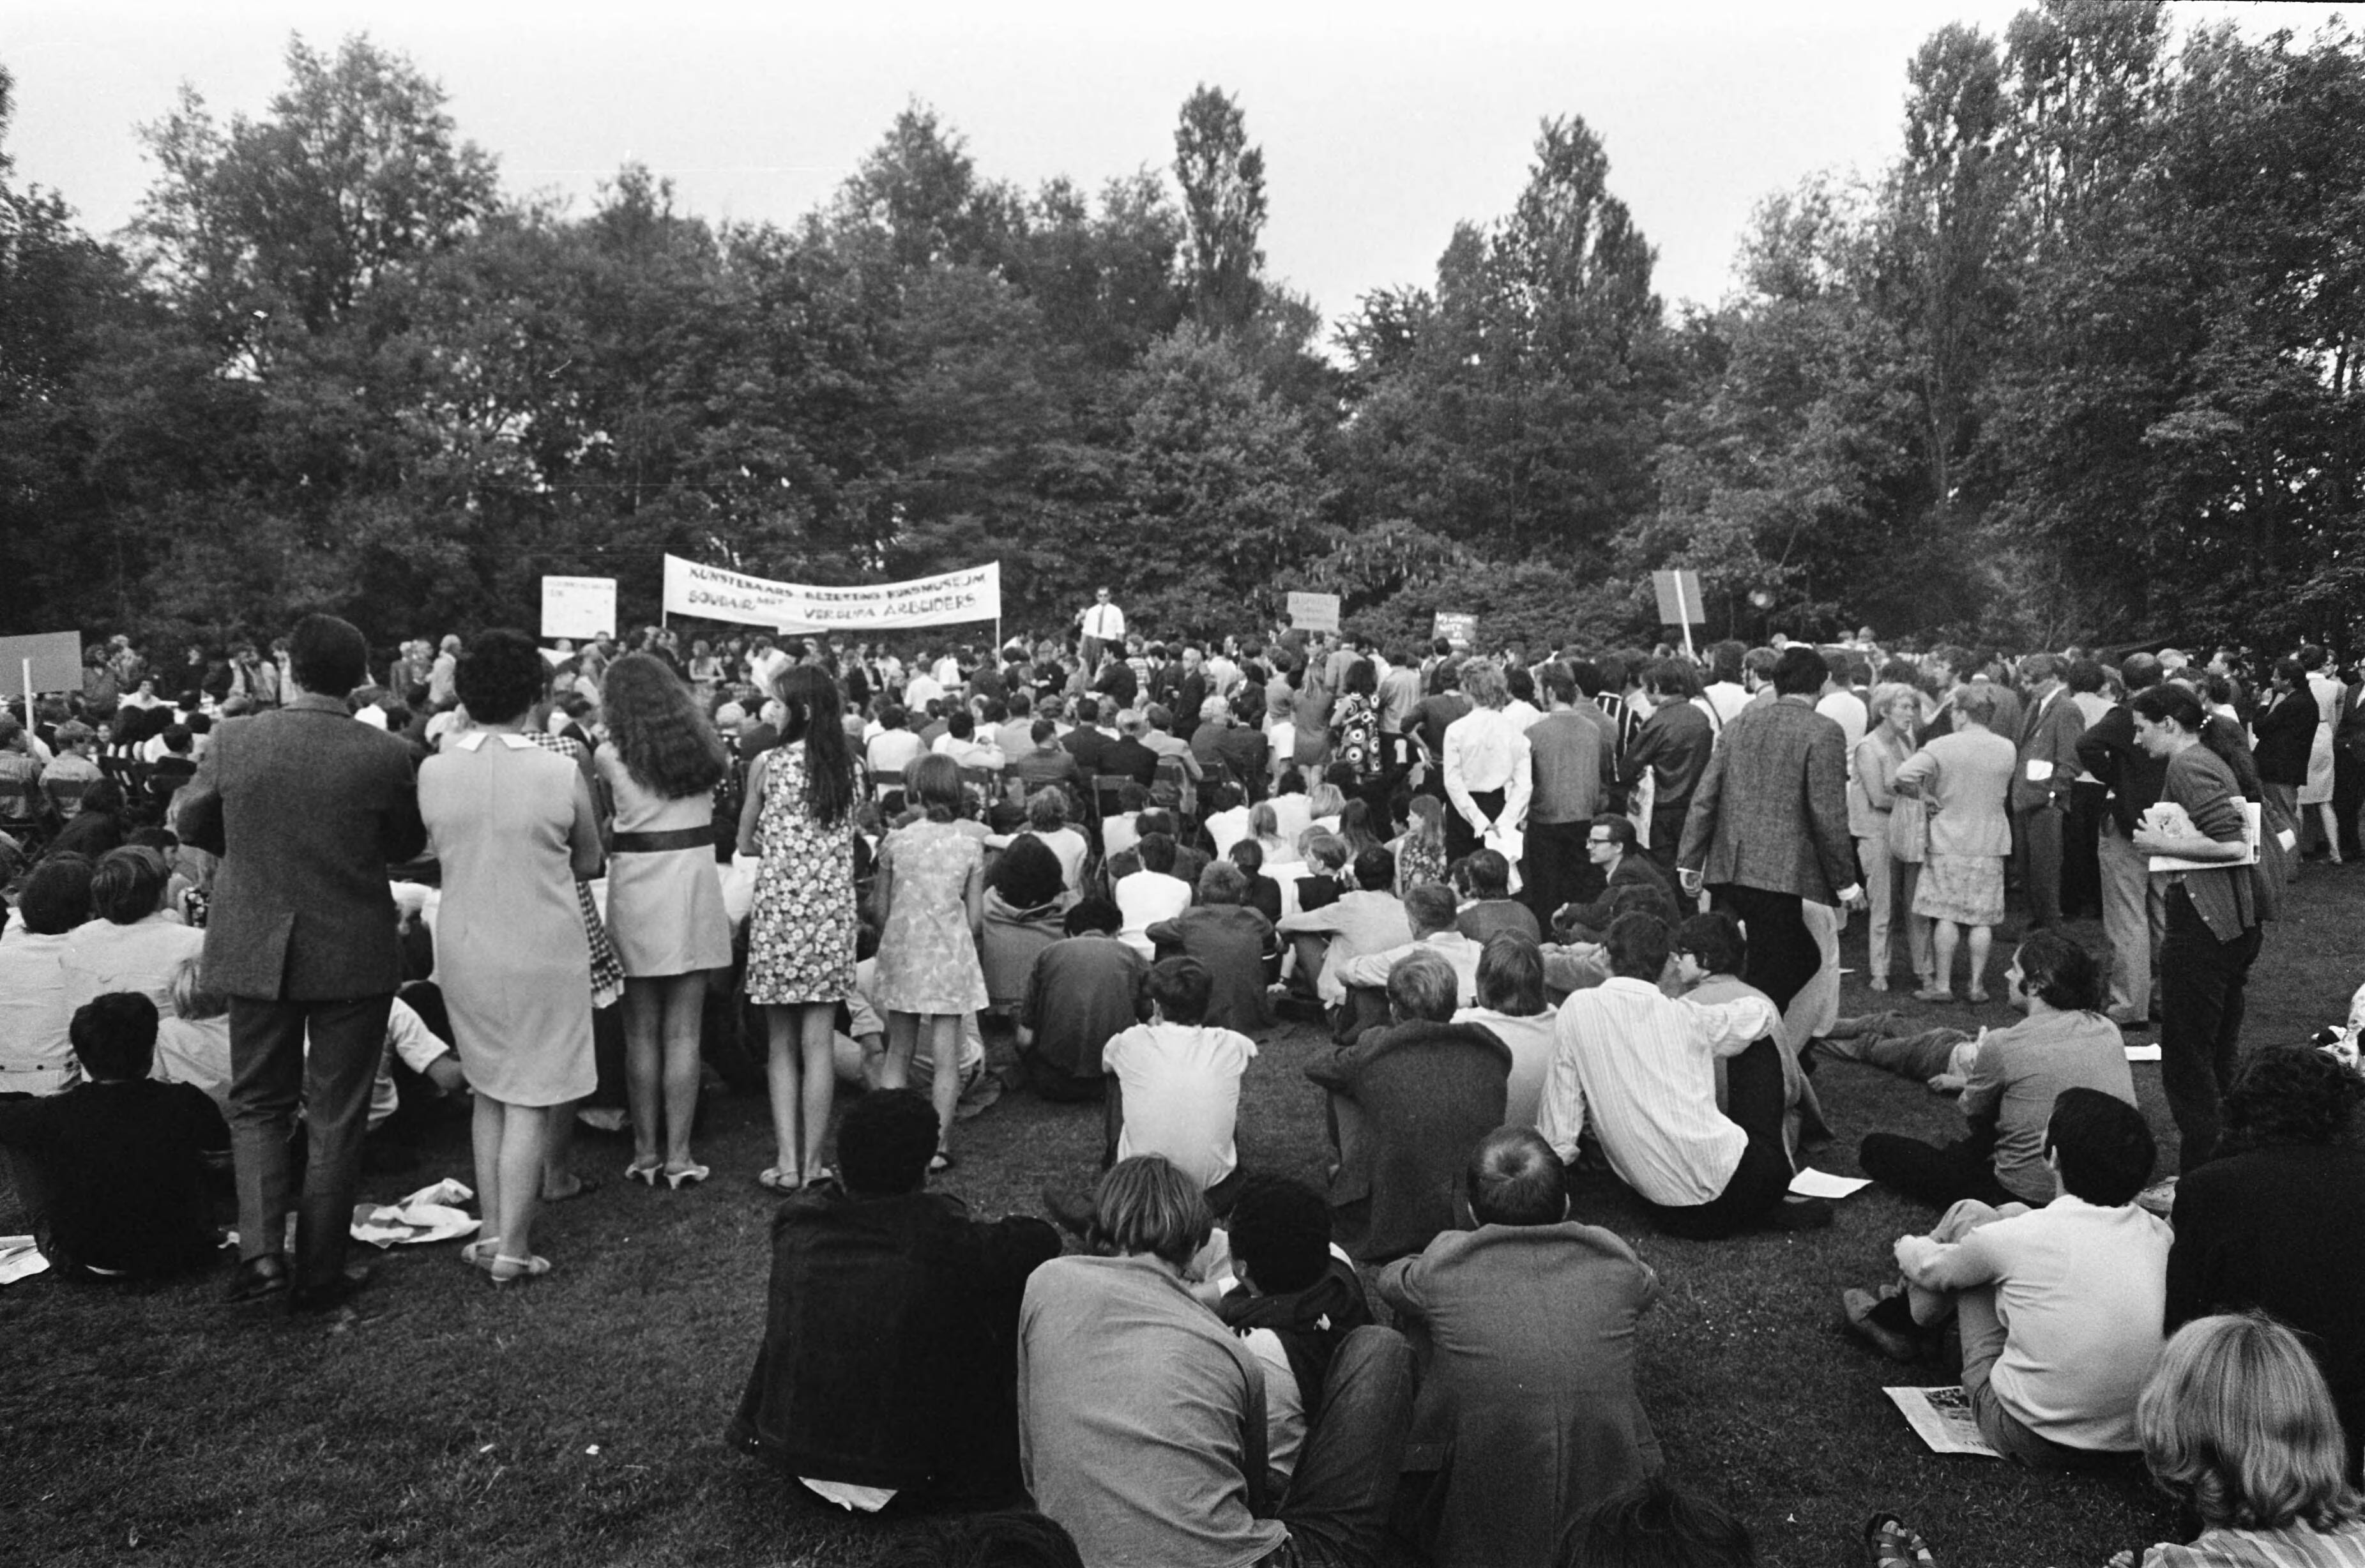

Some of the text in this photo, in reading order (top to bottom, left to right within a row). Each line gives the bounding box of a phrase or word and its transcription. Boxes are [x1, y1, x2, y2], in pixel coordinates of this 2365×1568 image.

[689, 568, 793, 597] KUNSTENAARS
[805, 591, 881, 601] BEZETTING
[883, 593, 977, 616] ARBEIDERS
